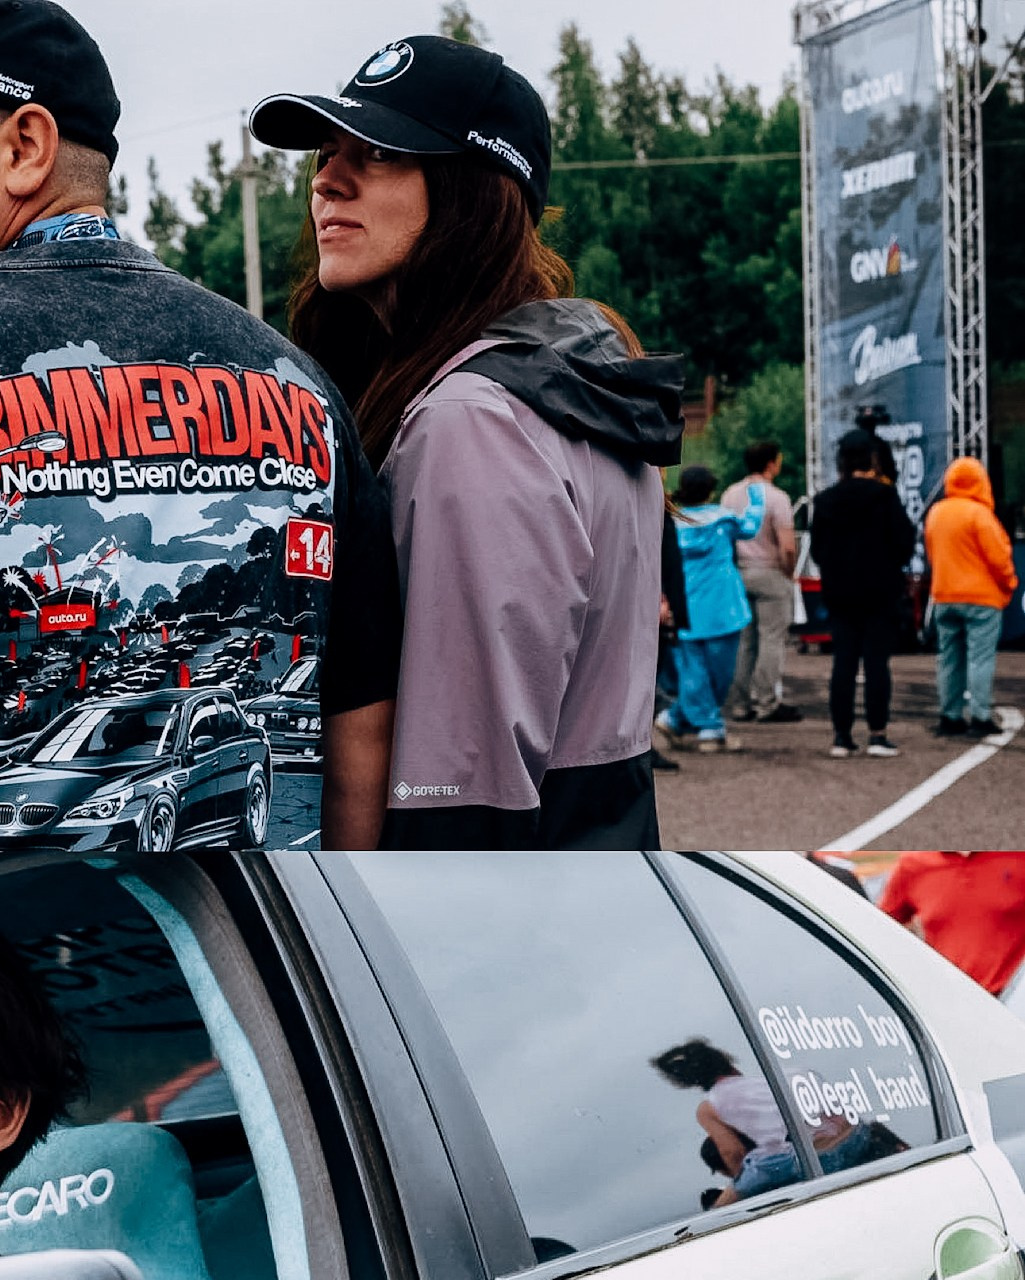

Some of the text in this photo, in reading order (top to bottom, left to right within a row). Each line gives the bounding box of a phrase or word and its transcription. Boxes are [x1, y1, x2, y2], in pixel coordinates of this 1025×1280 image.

[467, 130, 532, 179] Performance
[1, 463, 110, 497] Nothing
[114, 460, 176, 490] Even
[179, 458, 255, 488] Come
[48, 613, 87, 624] auto.ru
[412, 785, 460, 797] GORE-TEX
